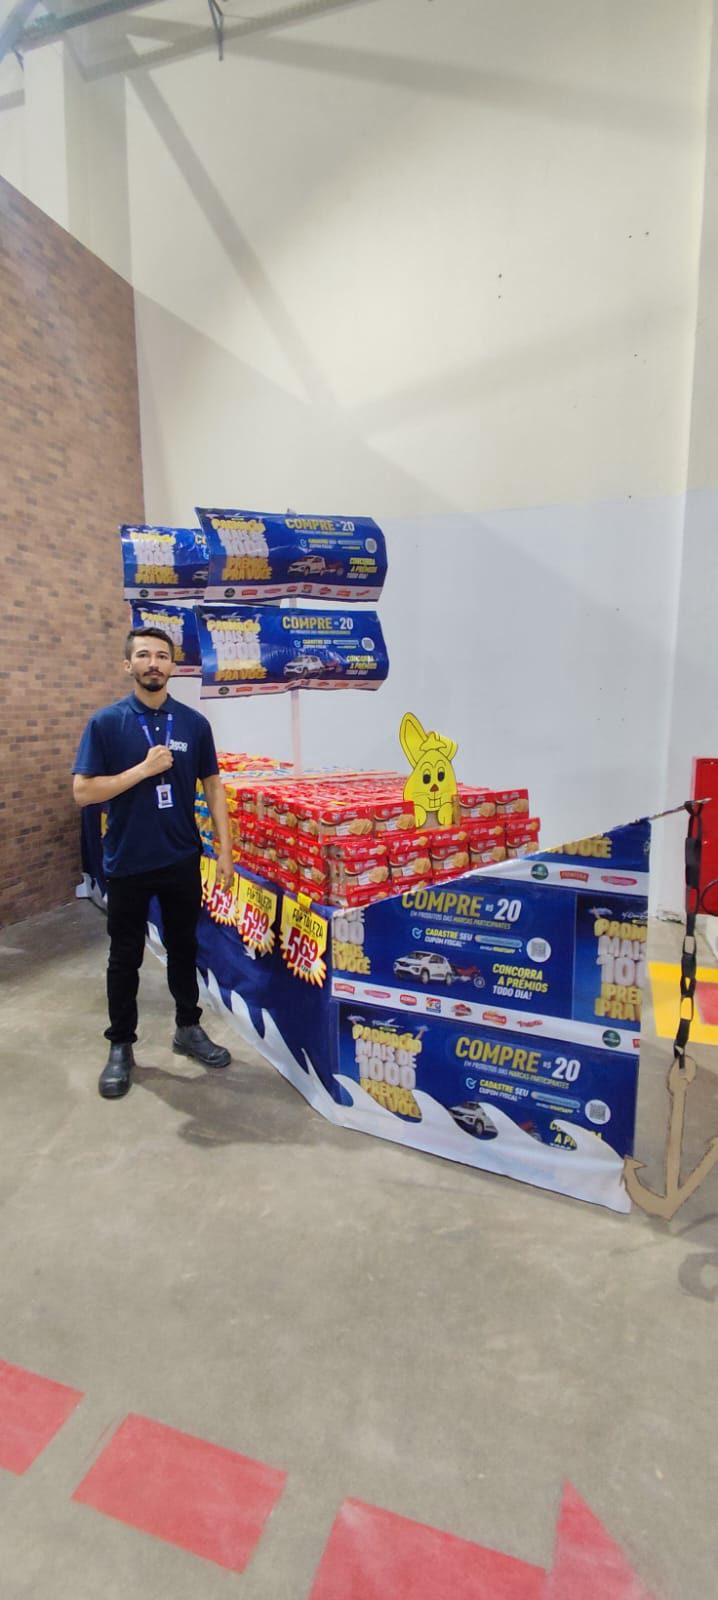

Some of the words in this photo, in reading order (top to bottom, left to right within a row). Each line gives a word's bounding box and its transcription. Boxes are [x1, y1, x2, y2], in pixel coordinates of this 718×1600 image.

[284, 518, 336, 531] COMPRE
[340, 520, 355, 532] 20
[282, 615, 333, 629] COMPRE
[340, 616, 354, 630] 20
[401, 889, 484, 917] COMPRE
[494, 898, 522, 922] 20
[425, 928, 459, 939] CADASTRE
[459, 932, 473, 941] SEU
[492, 963, 543, 980] CONCORRA
[492, 985, 513, 997] TODO
[514, 988, 533, 1000] DIA!
[497, 975, 505, 986] A
[506, 977, 549, 993] PRÊMIOS
[455, 1036, 541, 1073] COMPRE
[552, 1056, 581, 1082] 20
[355, 1054, 416, 1091] 1000
[479, 1079, 513, 1094] CADASTRE
[514, 1087, 529, 1097] SEU
